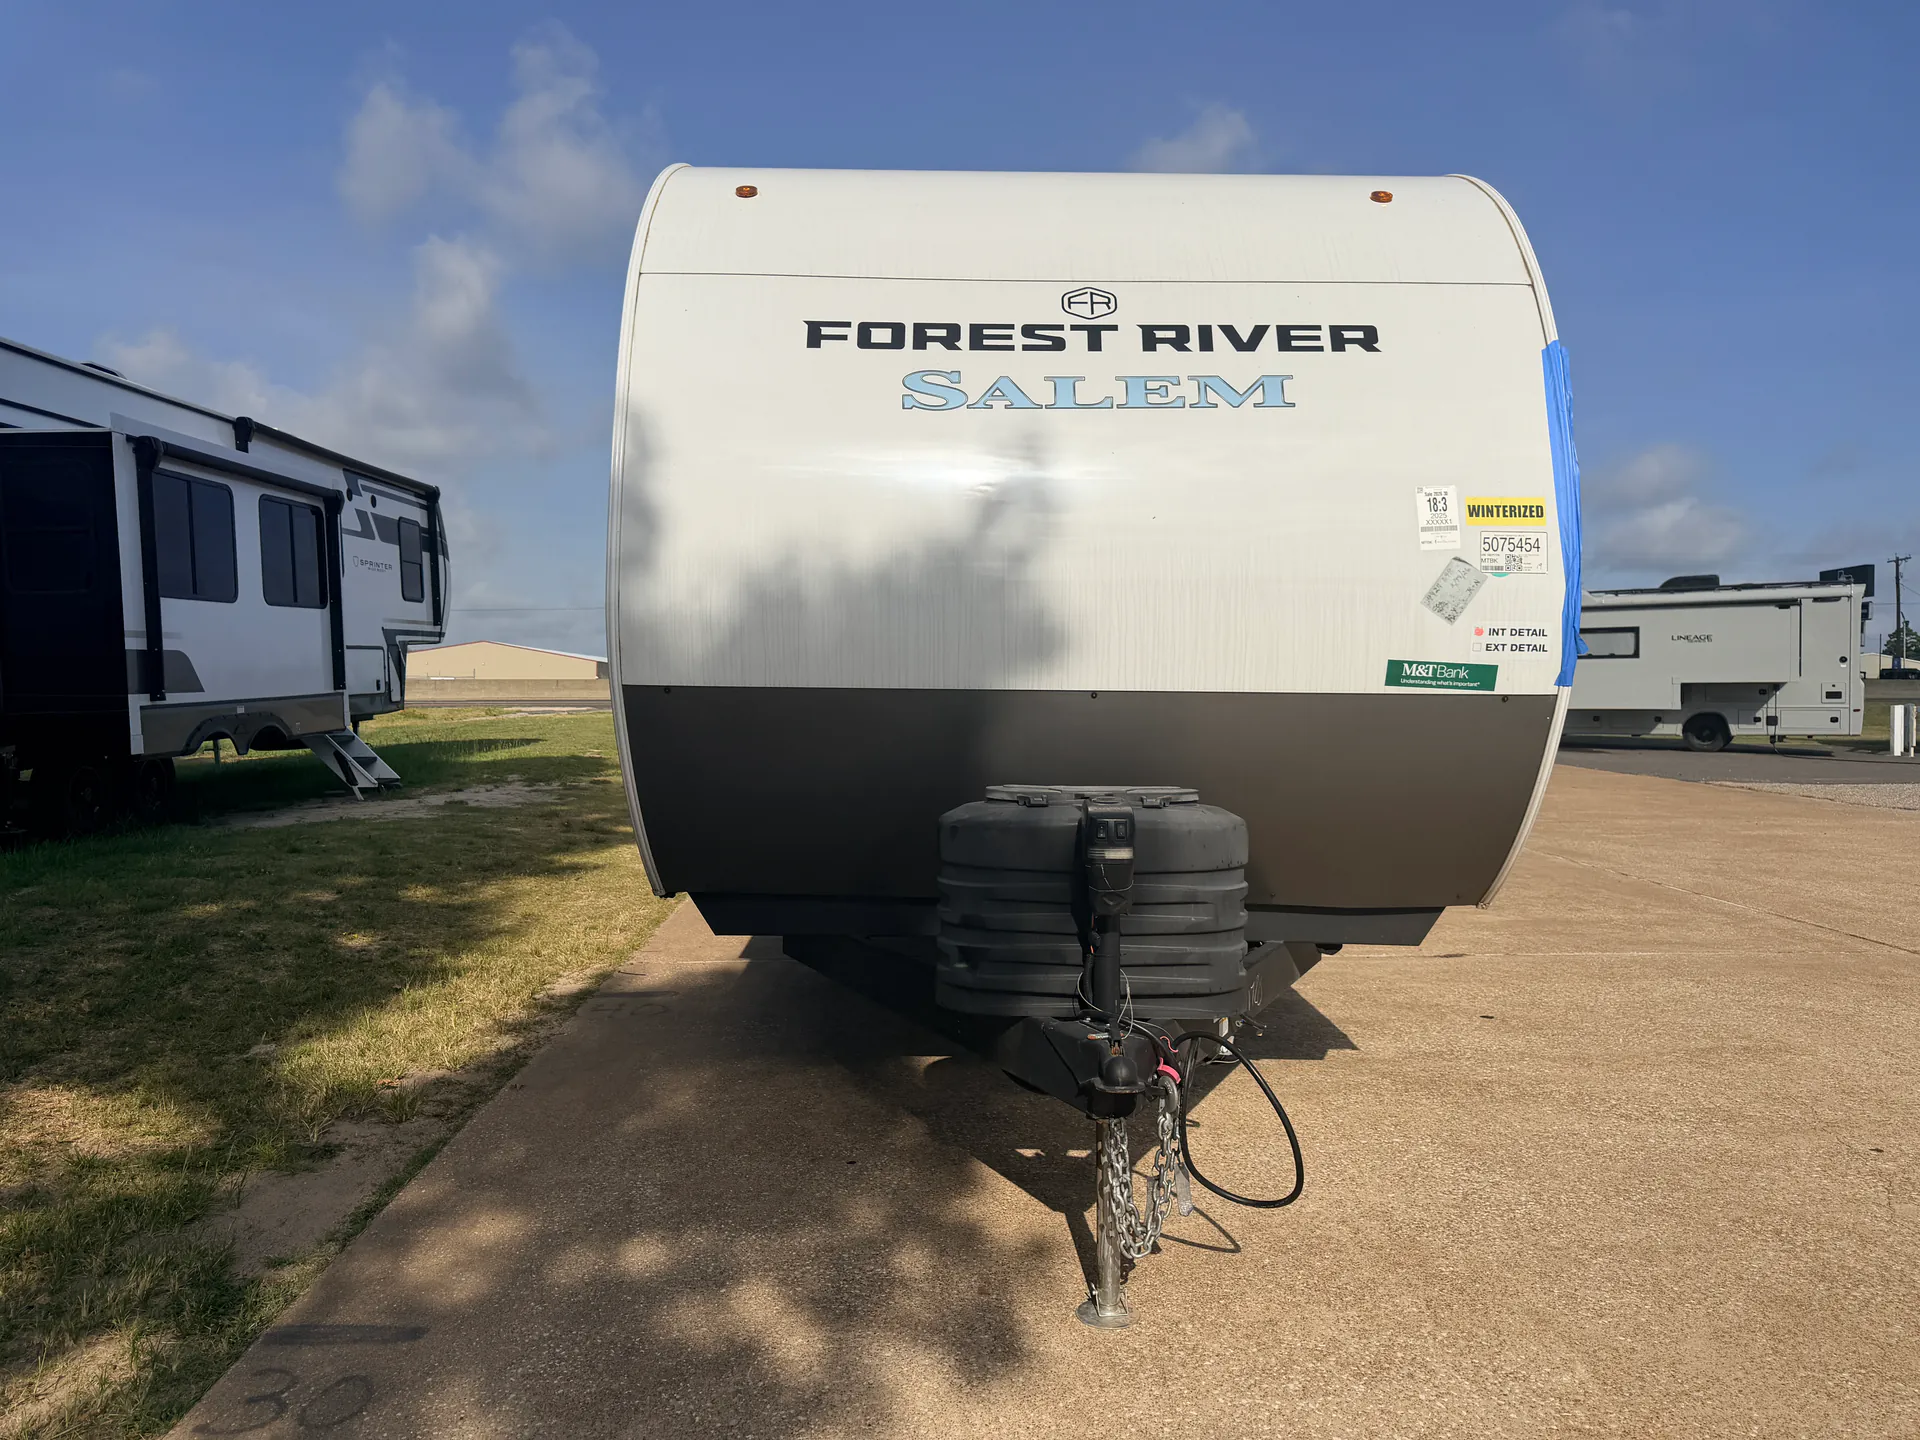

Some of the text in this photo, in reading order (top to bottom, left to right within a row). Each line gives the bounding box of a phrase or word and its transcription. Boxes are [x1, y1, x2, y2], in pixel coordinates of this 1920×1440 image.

[802, 320, 1382, 352] FOREST RIVER
[902, 370, 1295, 411] SALEM
[1427, 497, 1448, 512] 18:3
[1467, 504, 1544, 518] WINTERIZED
[1482, 536, 1541, 552] 5075454
[359, 559, 393, 570] SPRINTER
[1488, 628, 1548, 637] INT DETAIL
[1485, 643, 1548, 652] EXT DETAIL
[1436, 665, 1469, 679] Bank
[1400, 678, 1436, 686] Understanding
[191, 1367, 375, 1436] 30
